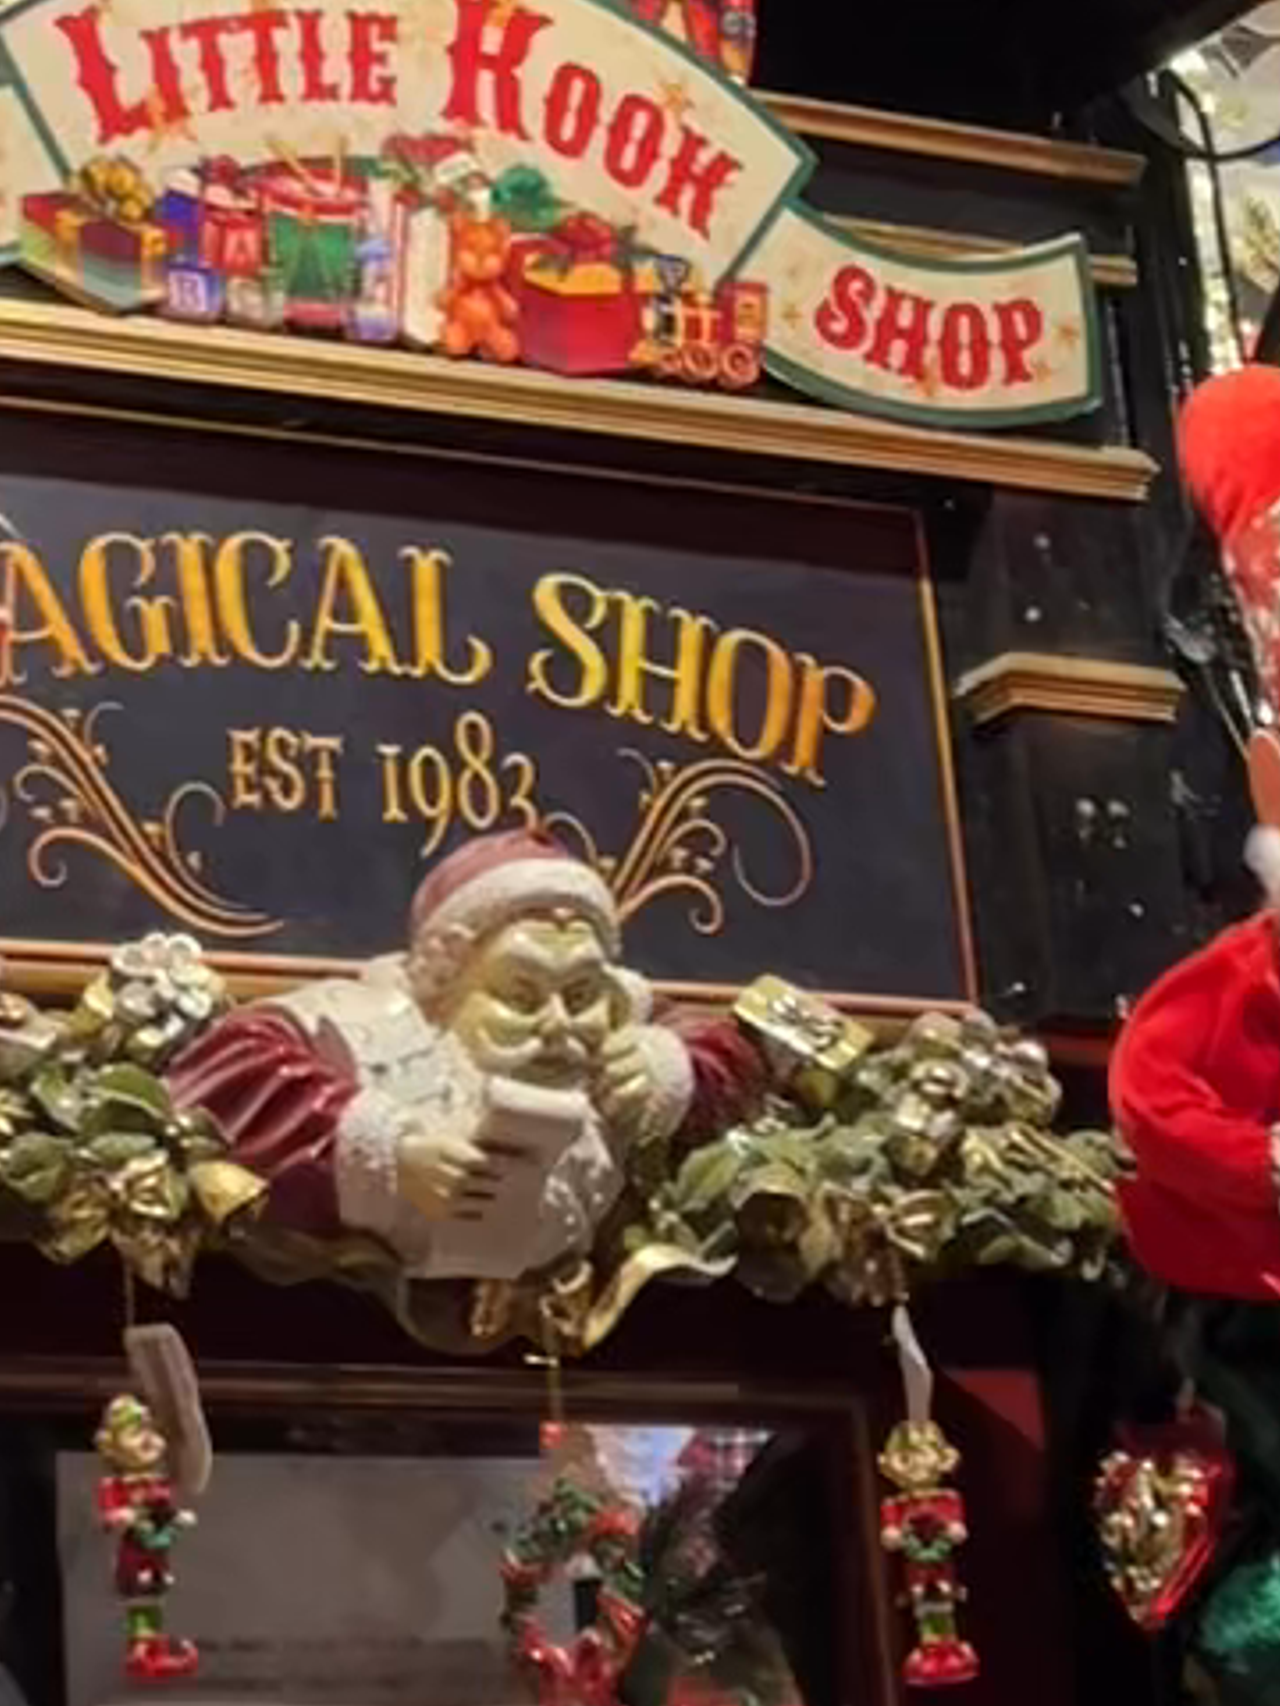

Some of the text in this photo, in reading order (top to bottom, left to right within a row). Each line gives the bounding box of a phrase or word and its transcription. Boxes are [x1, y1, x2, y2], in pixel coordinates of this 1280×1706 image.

[52, 1, 400, 148] LITTLE
[814, 264, 1046, 392] SHOP
[526, 572, 877, 786] SHOP
[227, 710, 540, 857] EST 1983
